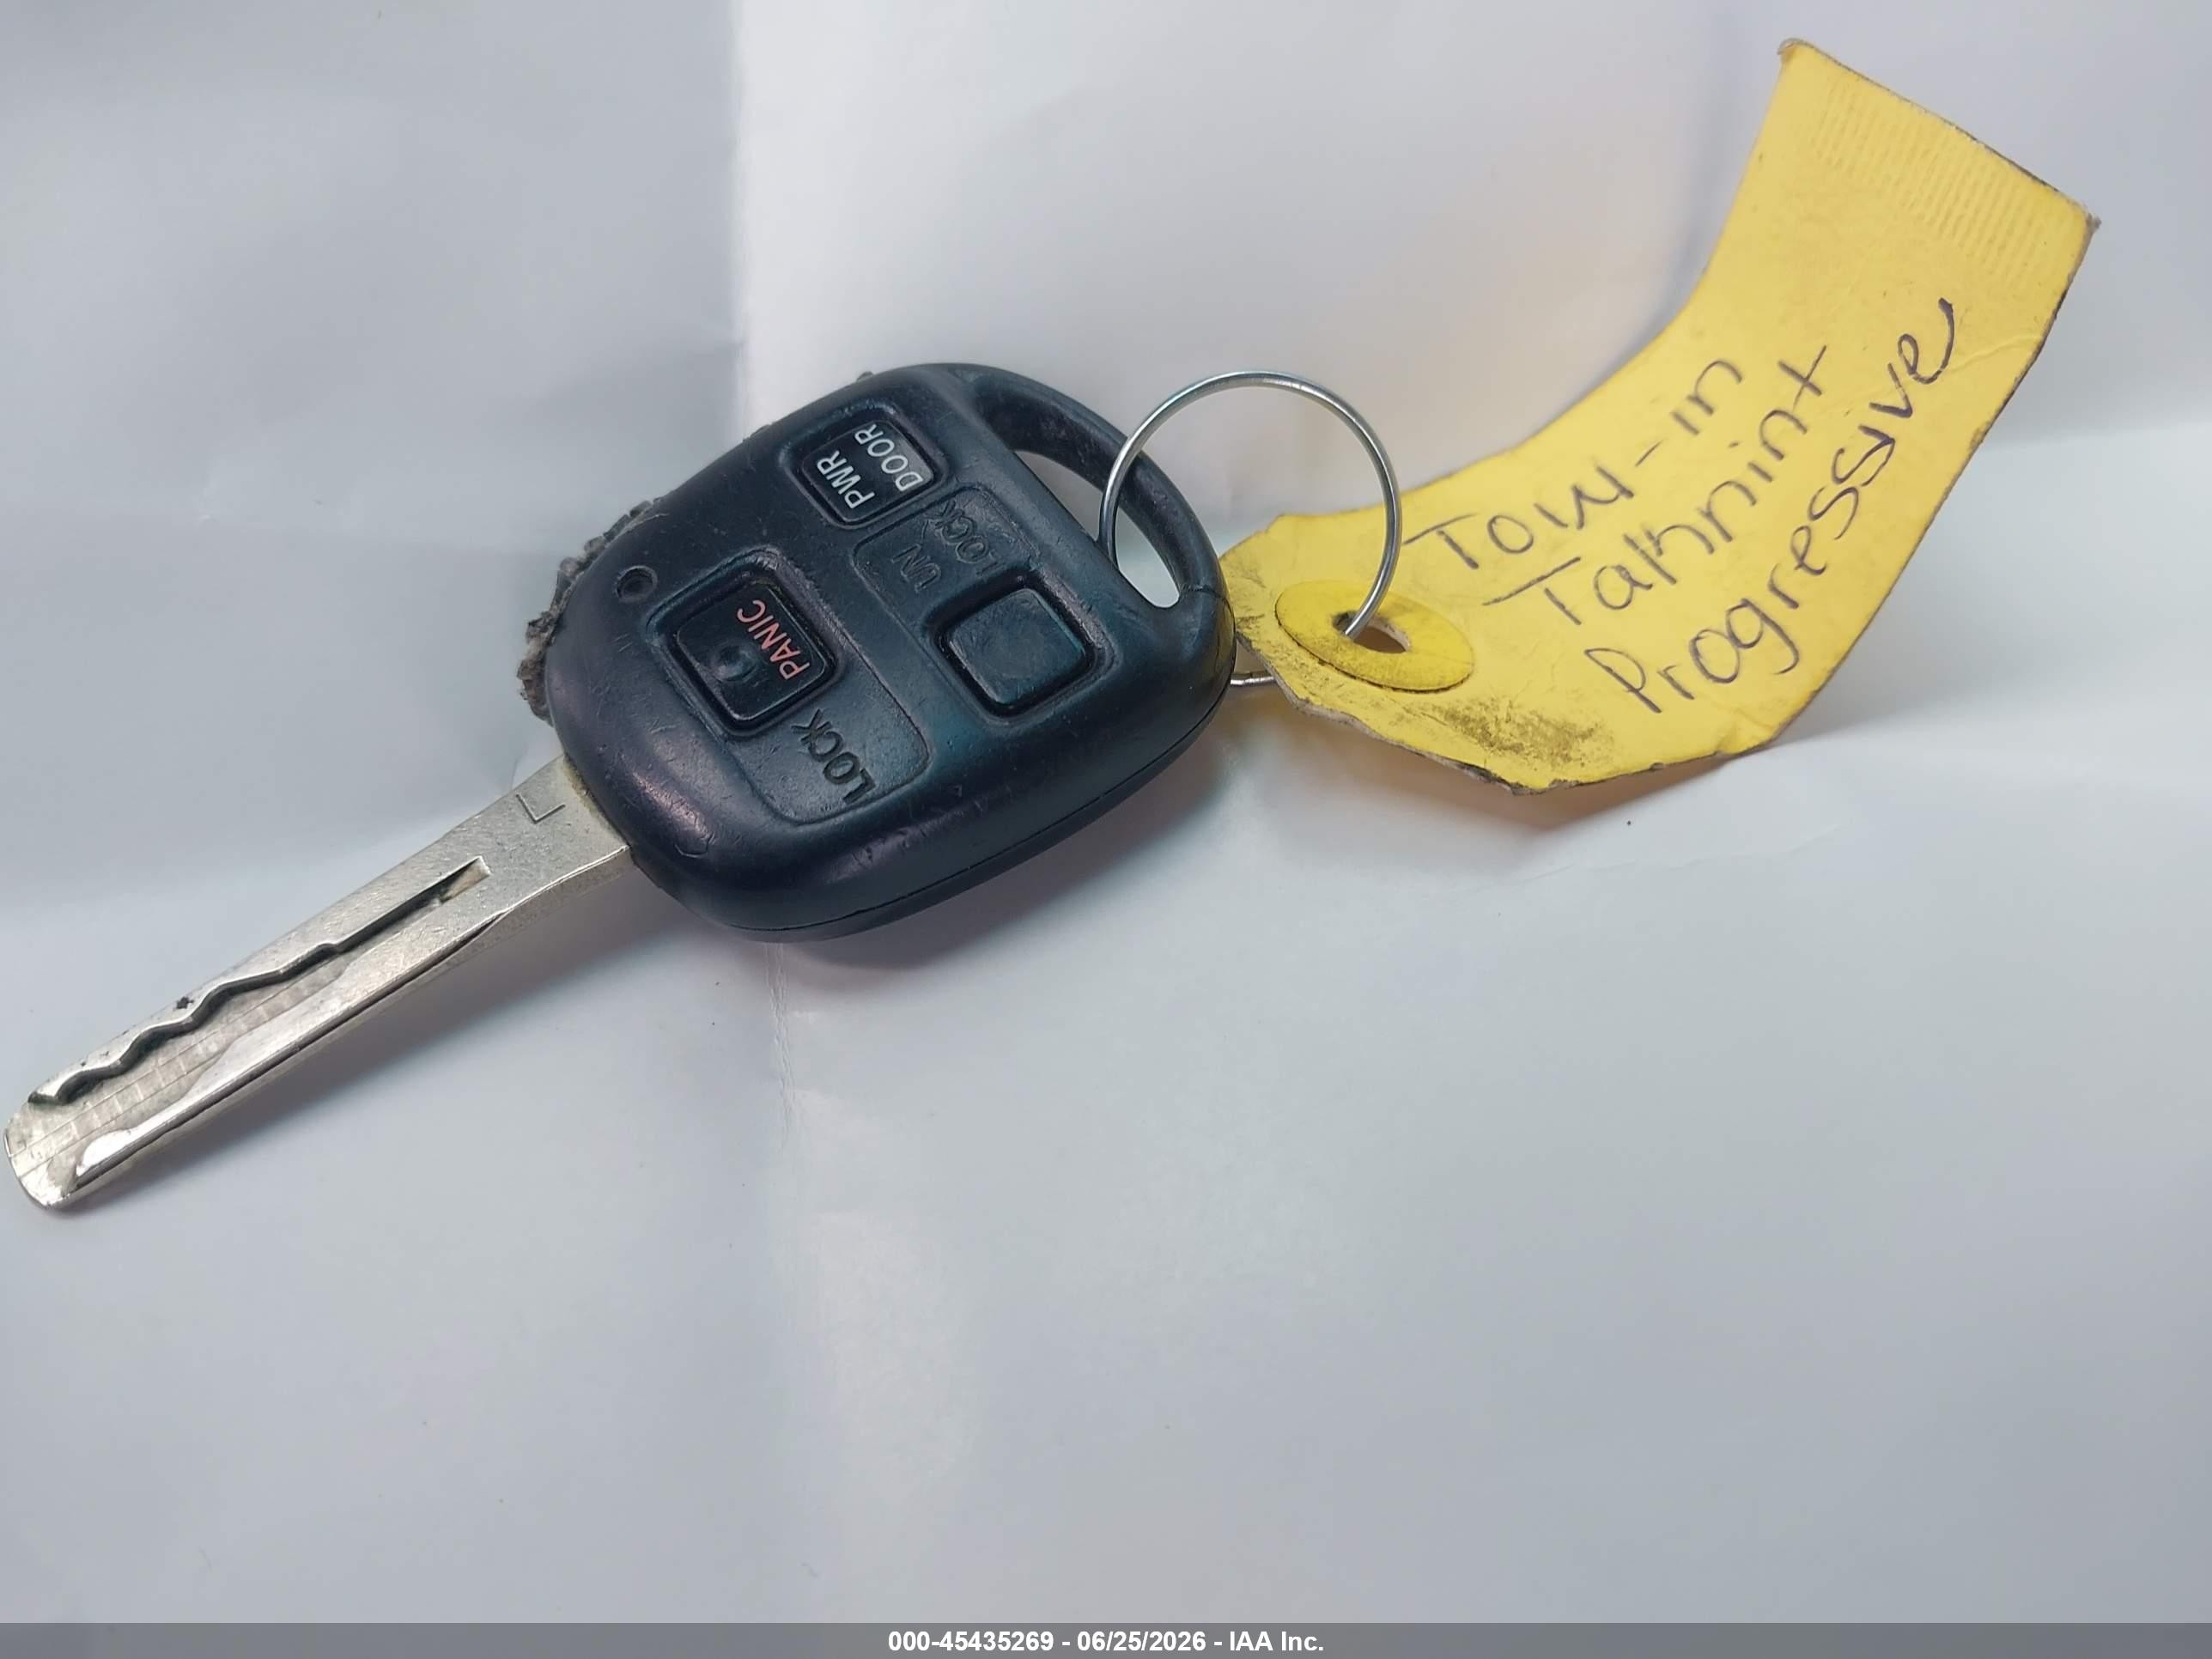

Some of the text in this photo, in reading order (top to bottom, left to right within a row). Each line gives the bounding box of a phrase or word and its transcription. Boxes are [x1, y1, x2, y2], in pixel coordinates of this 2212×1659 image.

[816, 450, 876, 509] PWR
[853, 422, 925, 493] DOOR
[1584, 297, 1954, 714] Progressive
[890, 543, 942, 593] UN
[735, 599, 811, 680] PANIC
[791, 708, 877, 805] LOCK
